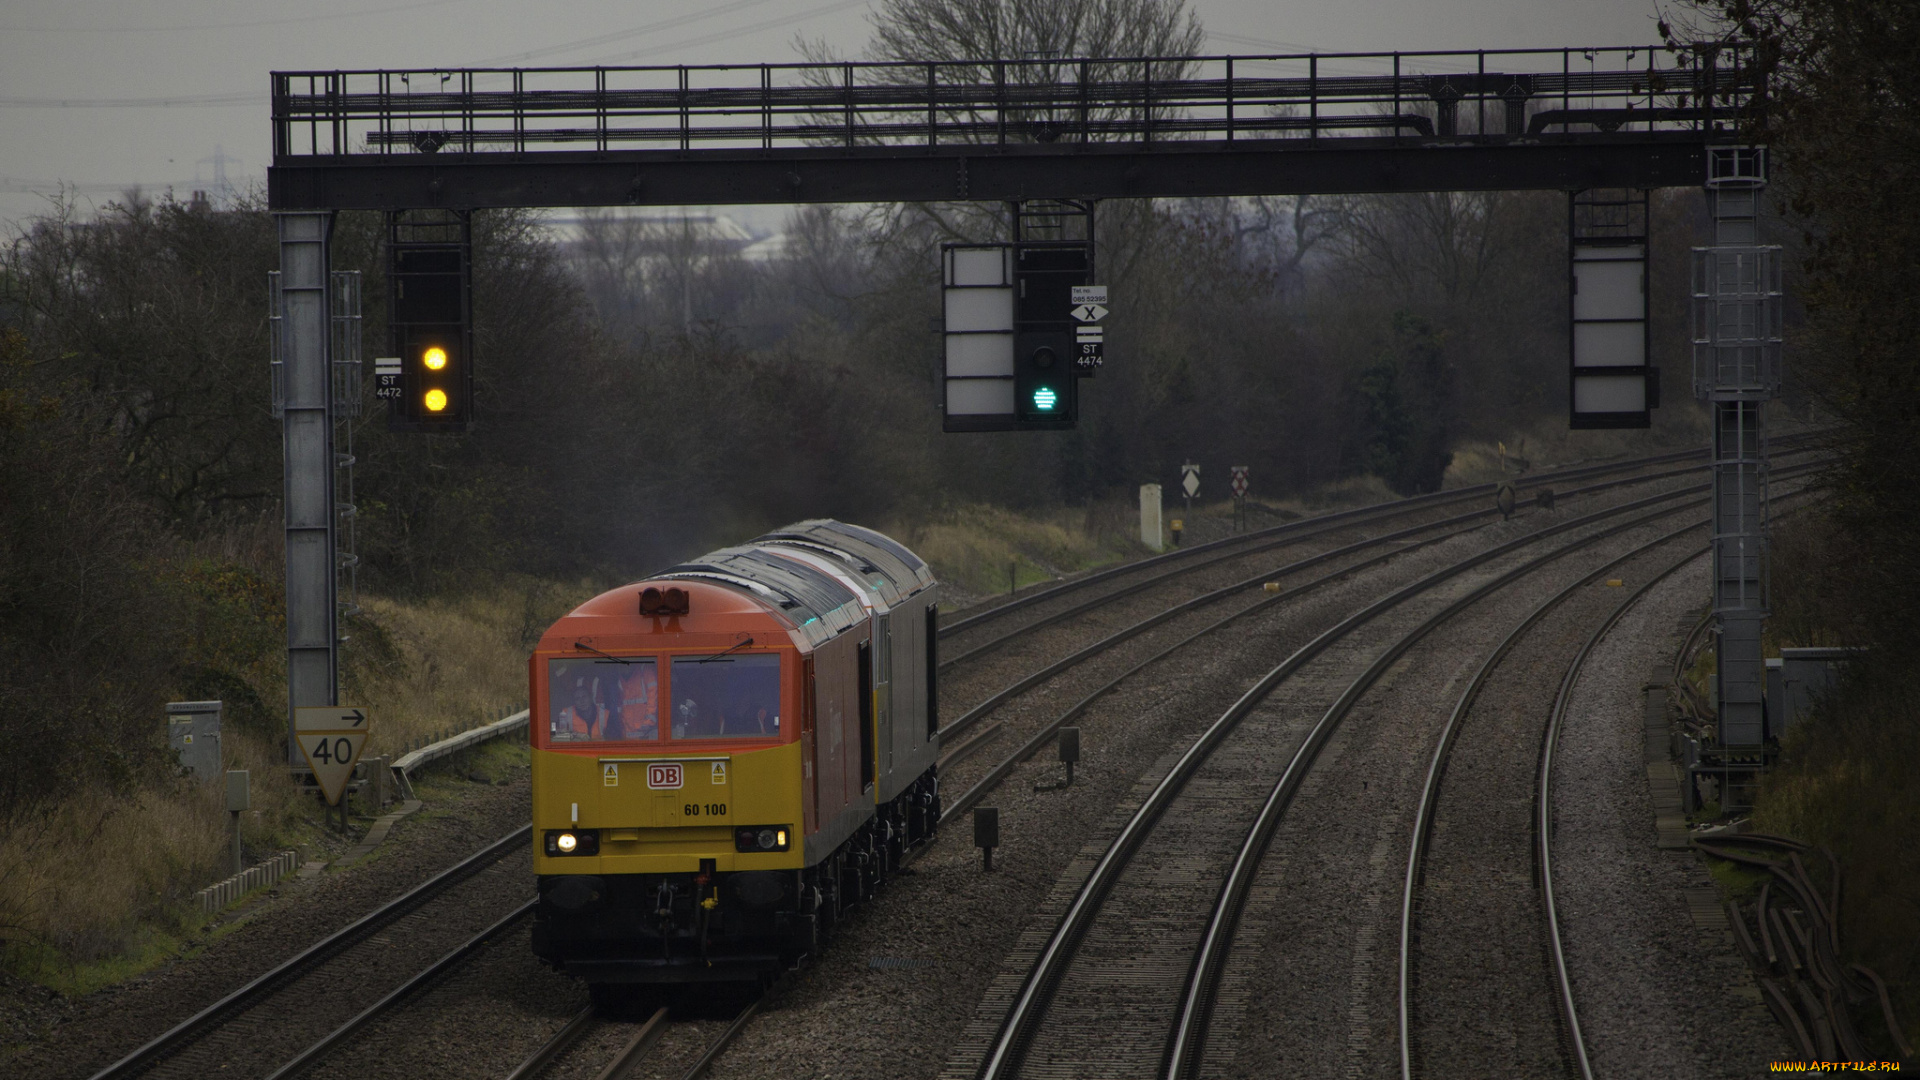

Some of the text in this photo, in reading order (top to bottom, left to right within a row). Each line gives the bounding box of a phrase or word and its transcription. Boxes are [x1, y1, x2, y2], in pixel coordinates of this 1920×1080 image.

[1084, 306, 1096, 320] X
[1083, 344, 1097, 354] ST
[1077, 356, 1103, 366] 4474
[381, 375, 396, 385] ST
[377, 387, 402, 397] 4472
[312, 737, 352, 765] 40
[652, 768, 678, 784] DB
[684, 803, 727, 816] 60 100
